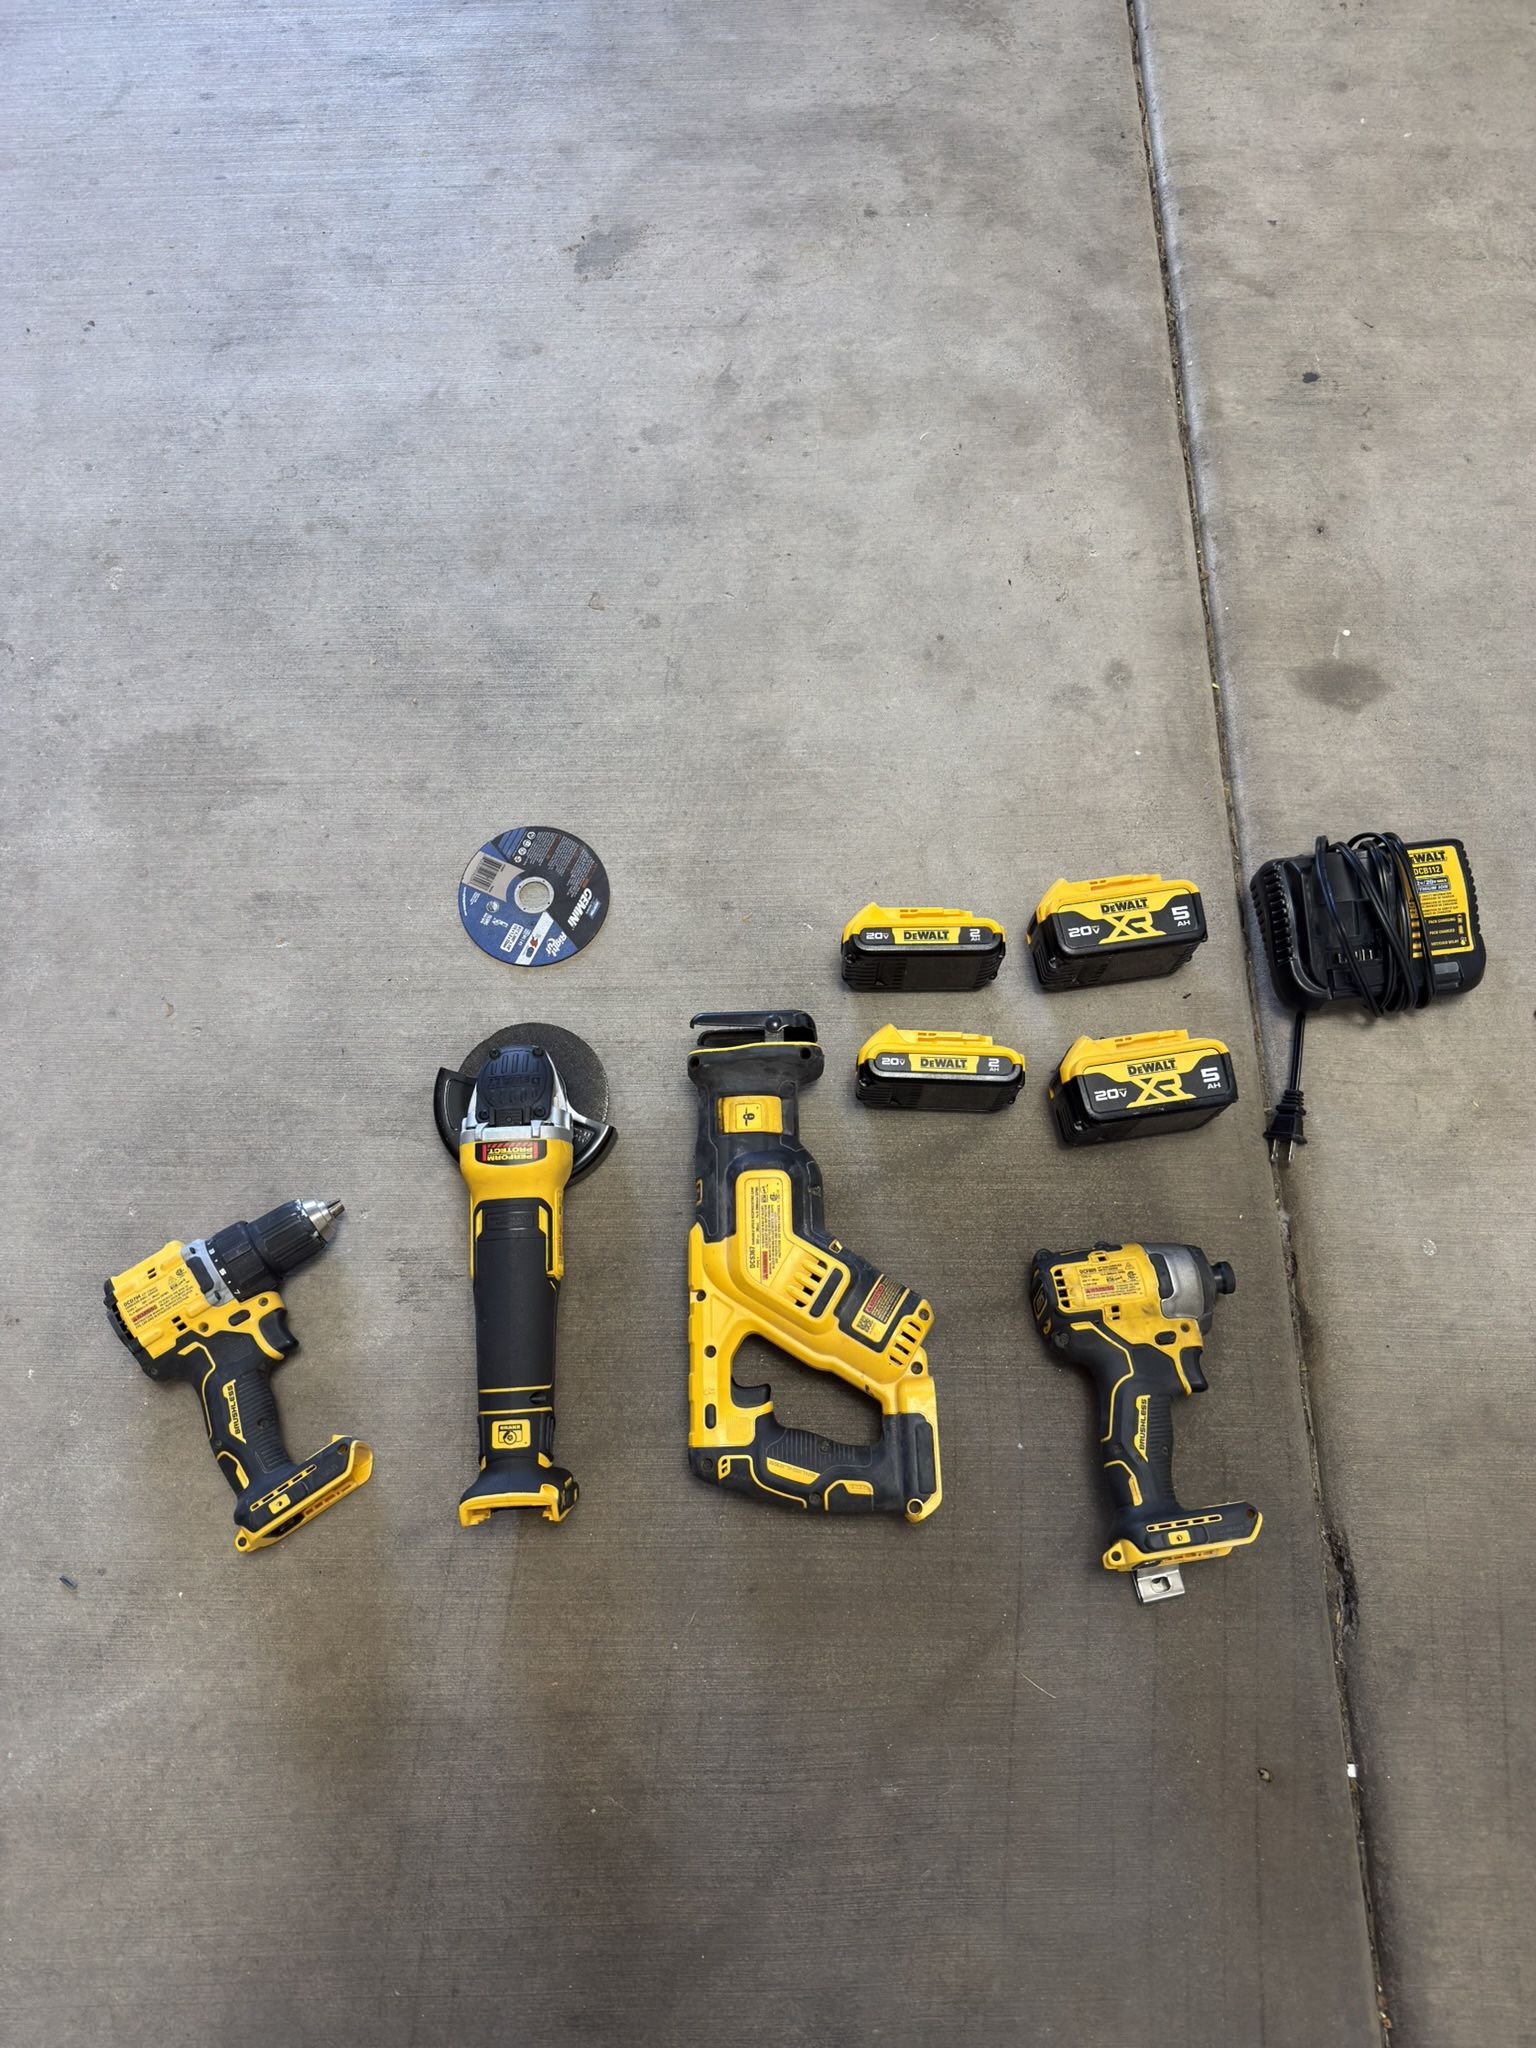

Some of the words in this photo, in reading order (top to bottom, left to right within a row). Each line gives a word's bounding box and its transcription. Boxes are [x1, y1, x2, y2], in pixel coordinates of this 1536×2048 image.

[1101, 898, 1148, 914] DEWALT
[1098, 912, 1167, 944] XR
[1171, 906, 1190, 920] 5
[904, 930, 949, 940] DEWALT
[970, 928, 980, 936] 2
[920, 1057, 967, 1068] DEWALT
[988, 1058, 1000, 1067] 2
[1126, 1058, 1176, 1076] DEWALT
[1126, 1074, 1196, 1108] XR
[1200, 1067, 1220, 1083] 5
[233, 1288, 241, 1296] 7
[228, 1386, 240, 1434] BRUSHLESS
